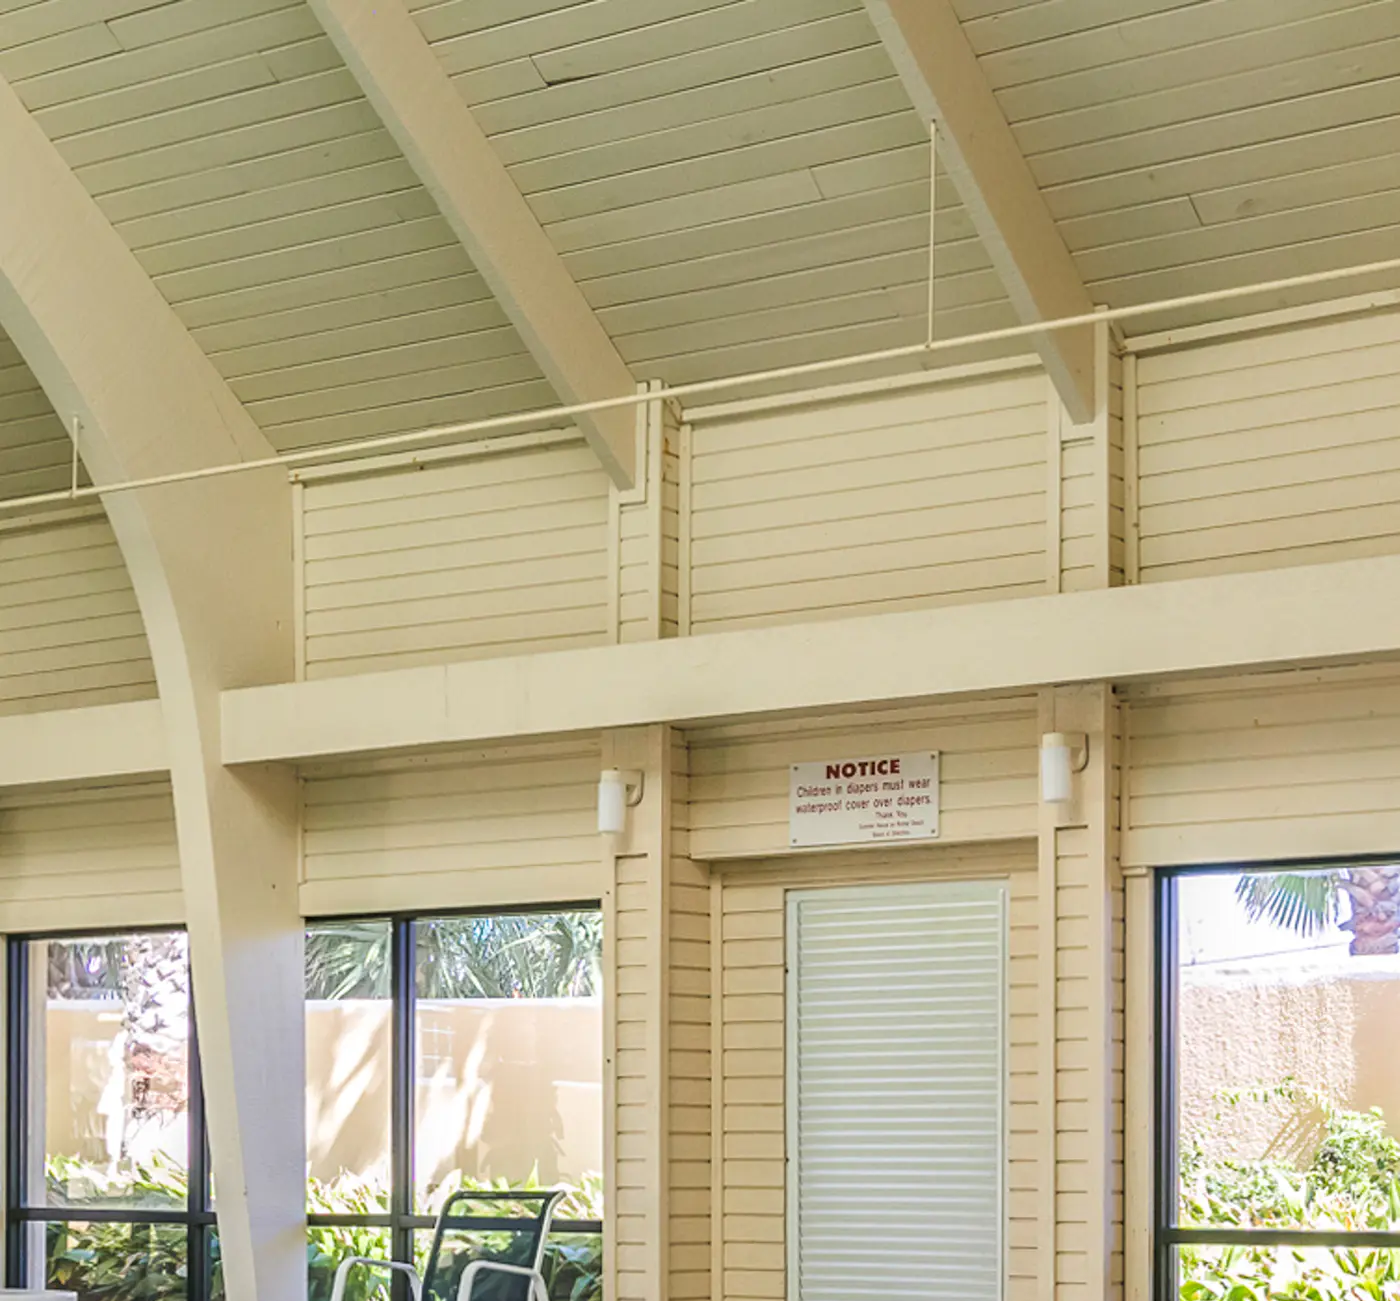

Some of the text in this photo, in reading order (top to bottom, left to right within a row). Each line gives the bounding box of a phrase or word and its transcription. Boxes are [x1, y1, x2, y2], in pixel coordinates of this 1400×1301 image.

[826, 758, 900, 779] NOTICE
[797, 778, 930, 798] Children in diapers must wear
[796, 800, 842, 815] waterproof
[846, 800, 870, 810] cover
[873, 798, 892, 808] over
